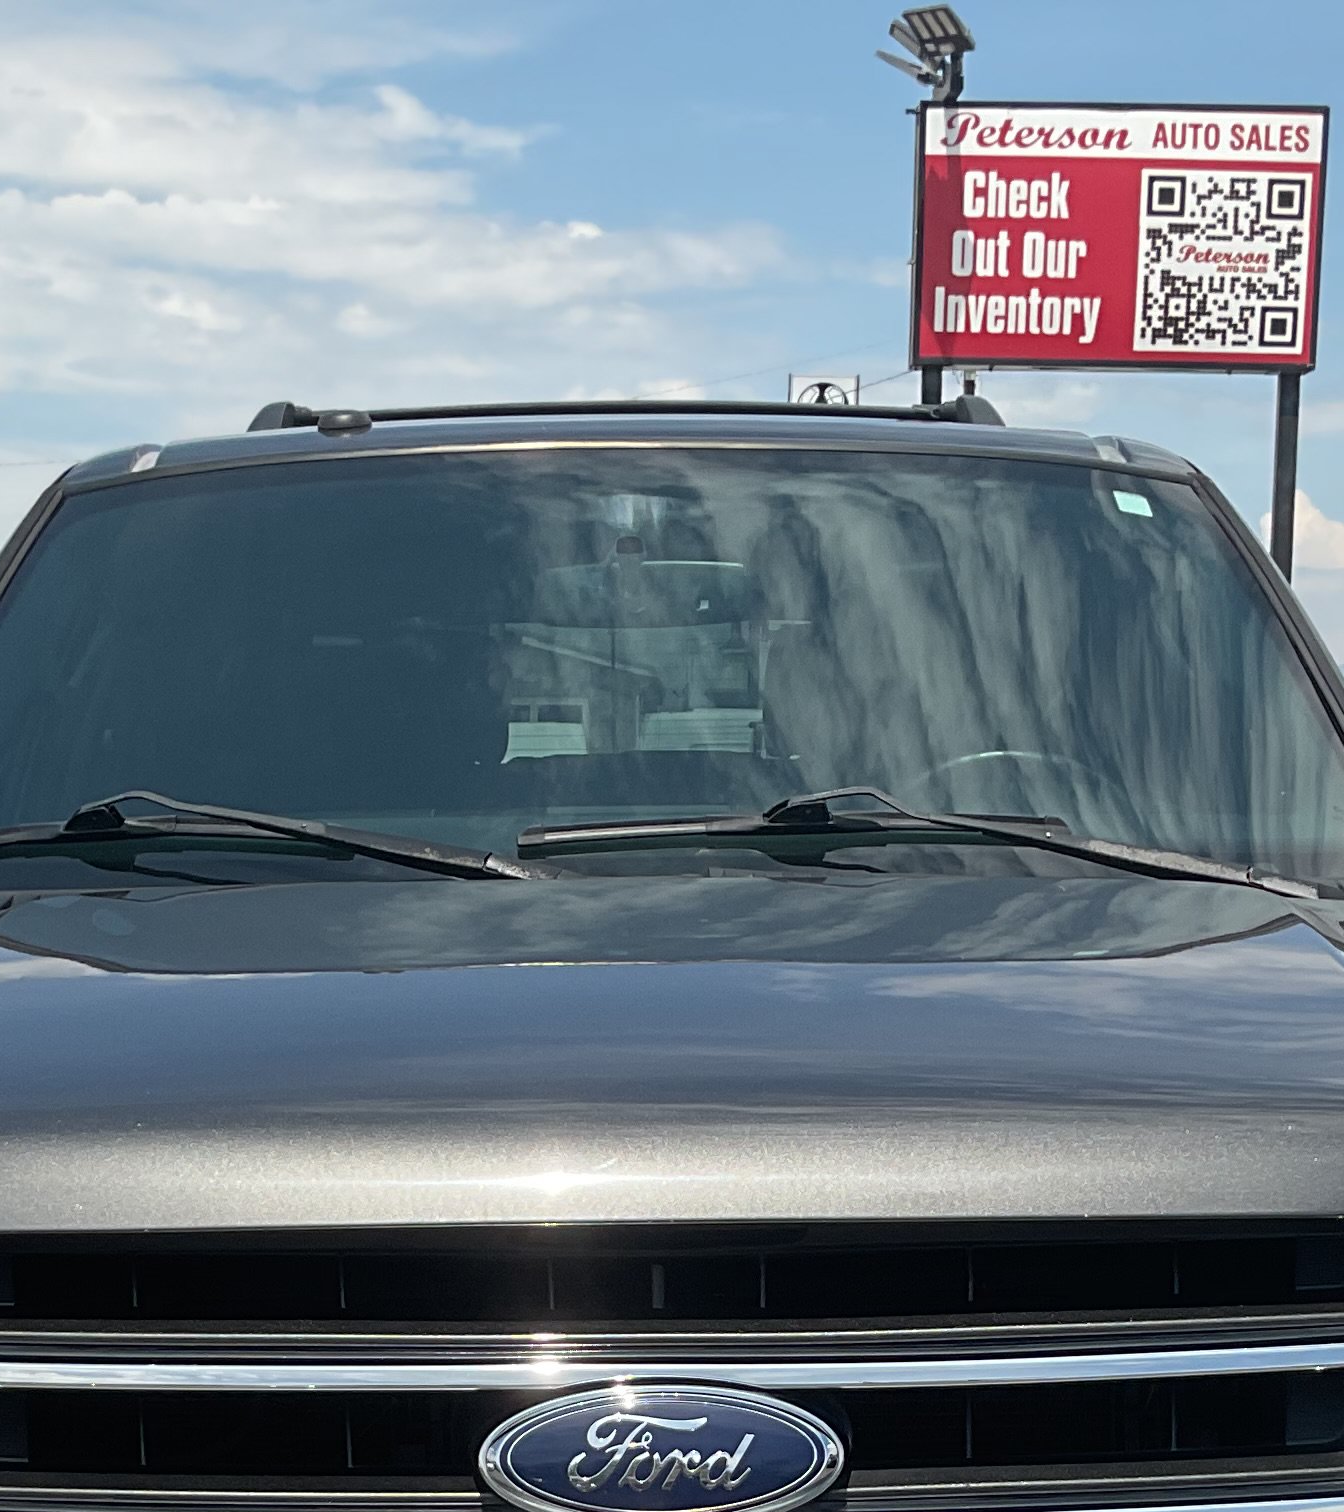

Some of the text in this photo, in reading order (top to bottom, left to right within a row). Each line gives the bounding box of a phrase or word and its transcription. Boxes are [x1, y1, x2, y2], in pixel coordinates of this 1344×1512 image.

[940, 113, 1310, 153] Peterson AUTO SALES
[962, 170, 1070, 220] Check
[951, 230, 1087, 279] Out Our
[1176, 244, 1270, 264] Peterson
[934, 286, 1102, 345] Inventory
[567, 1412, 755, 1493] Ford
